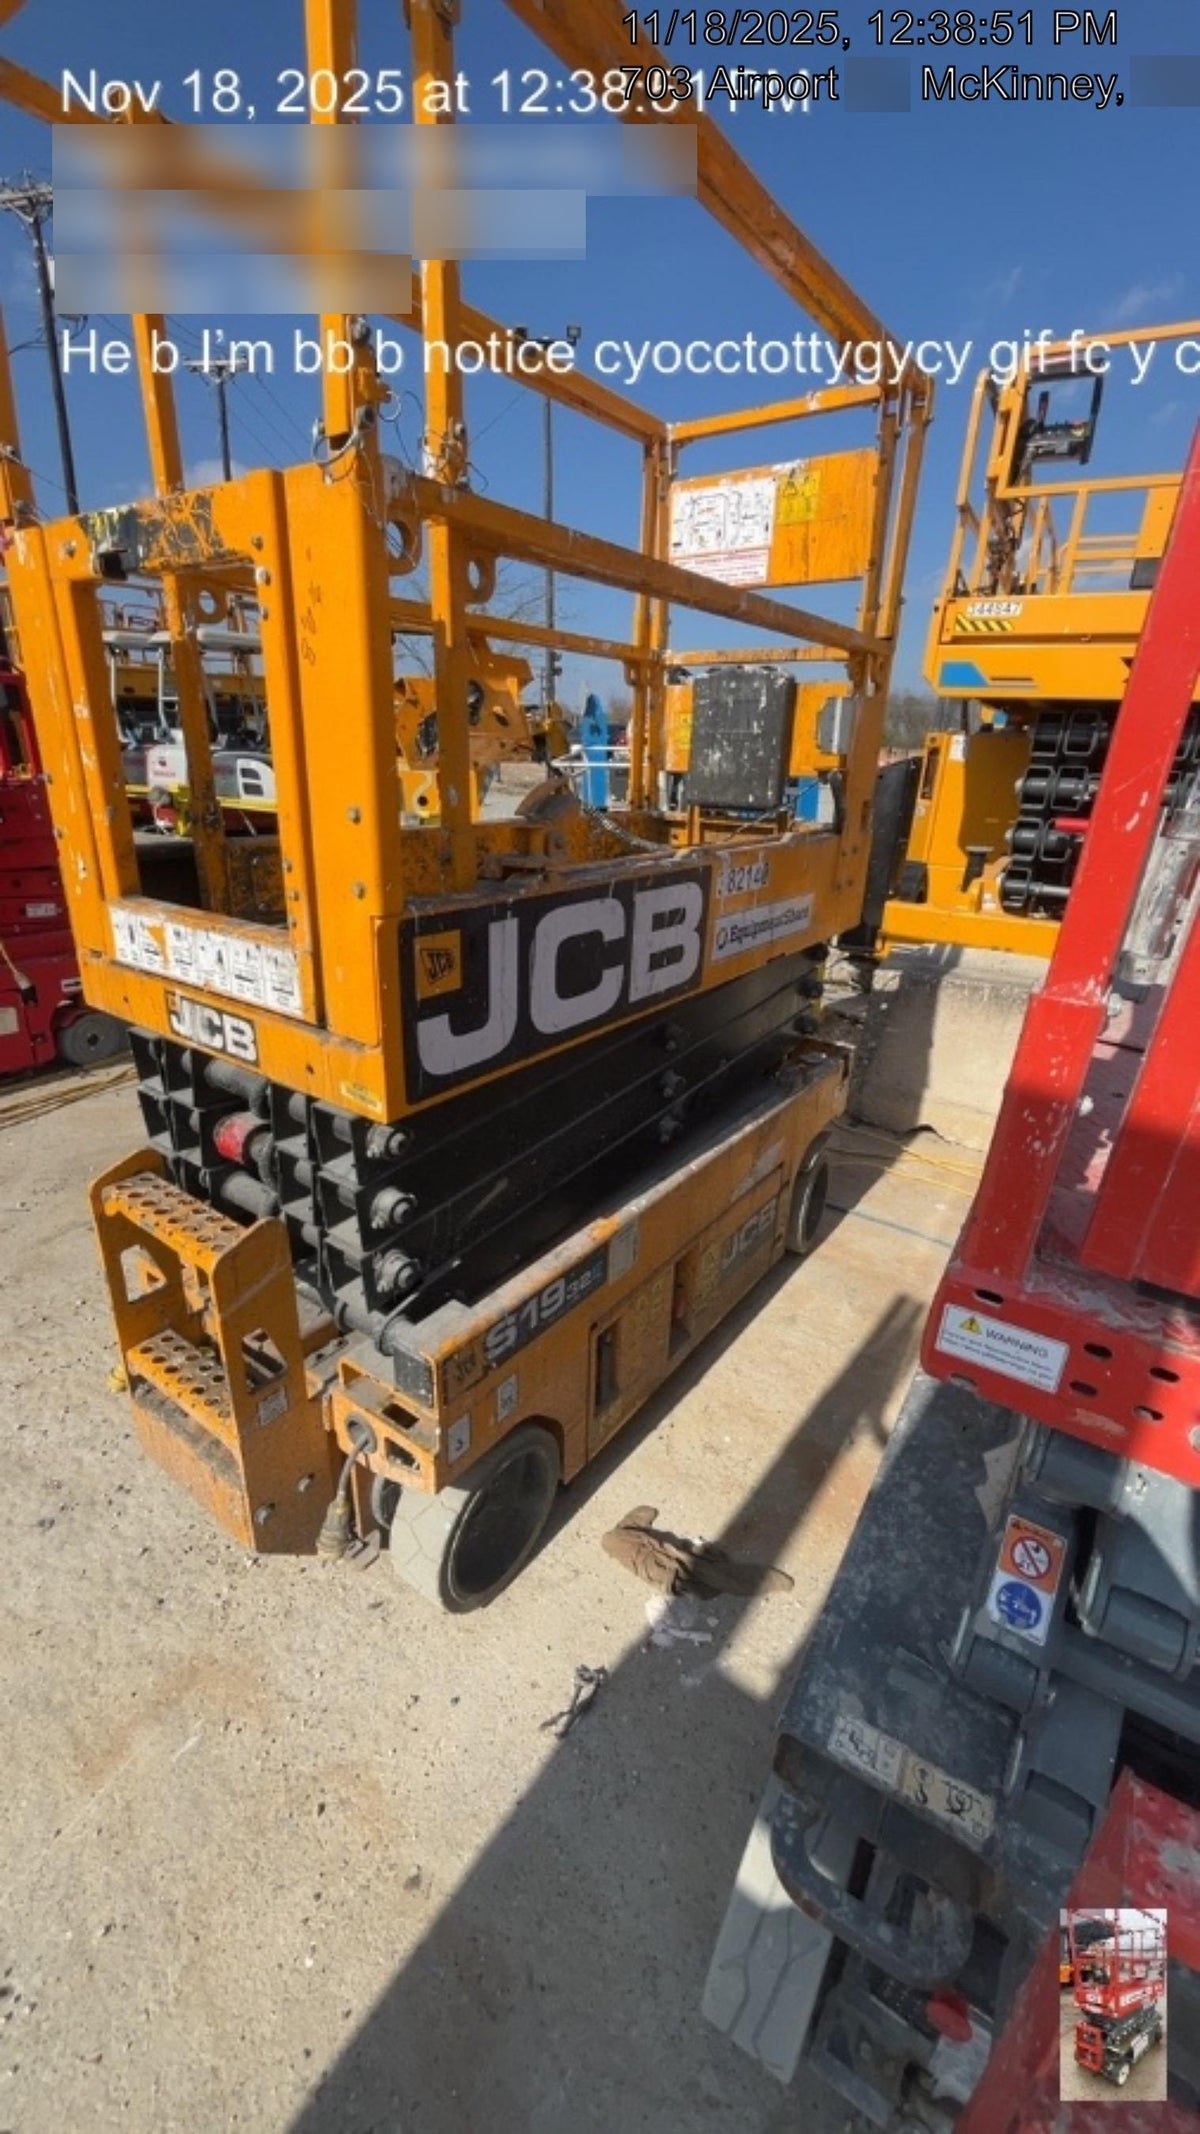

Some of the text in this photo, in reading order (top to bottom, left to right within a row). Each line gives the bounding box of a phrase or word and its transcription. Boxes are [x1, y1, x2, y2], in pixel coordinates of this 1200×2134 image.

[417, 882, 703, 1075] JCB
[170, 993, 257, 1062] JCB
[721, 1198, 777, 1270] JCB
[985, 1328, 1049, 1358] WARNING
